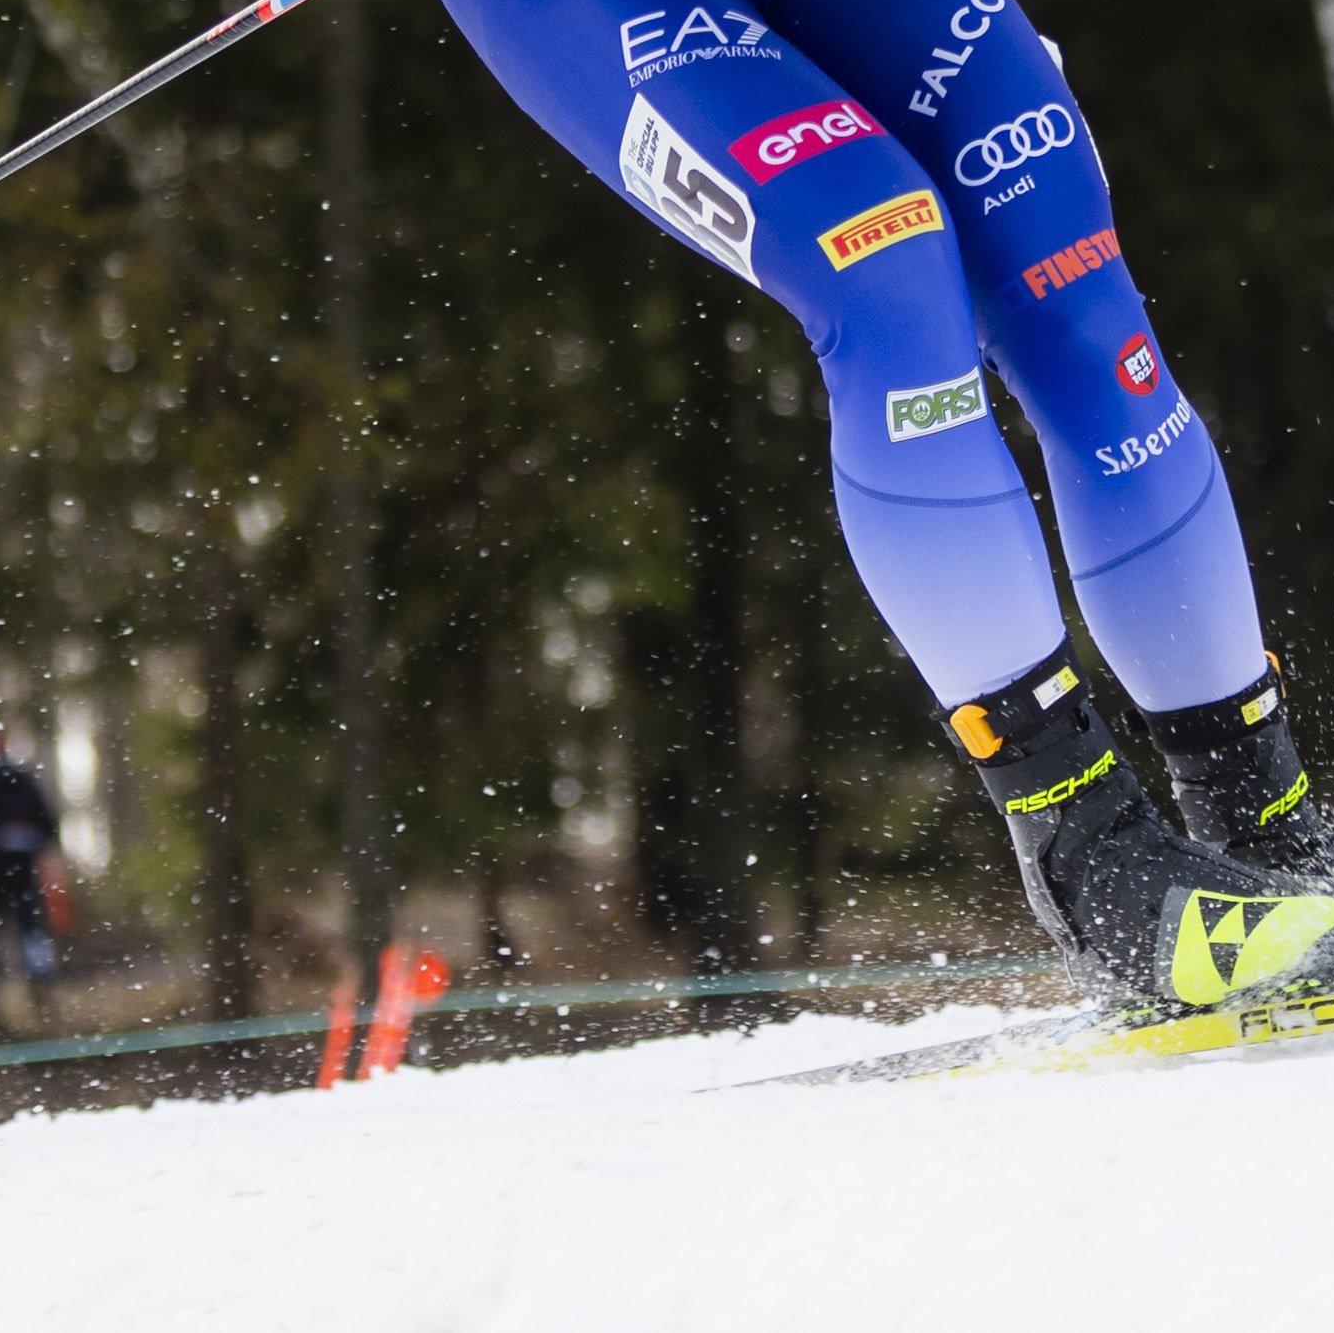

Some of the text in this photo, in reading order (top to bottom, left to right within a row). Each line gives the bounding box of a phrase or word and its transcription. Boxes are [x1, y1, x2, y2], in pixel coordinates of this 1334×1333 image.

[620, 7, 769, 71] EA7
[628, 45, 782, 88] EMPORIO ARMANI
[627, 138, 639, 160] THE
[636, 117, 655, 169] OFFICIAL
[644, 129, 660, 178] IBU APP
[758, 104, 872, 166] enel
[984, 174, 1036, 216] Audi
[830, 198, 935, 260] PIRELLI
[1123, 345, 1151, 376] RTL
[892, 377, 982, 432] FORST
[1005, 749, 1117, 815] FISCHER
